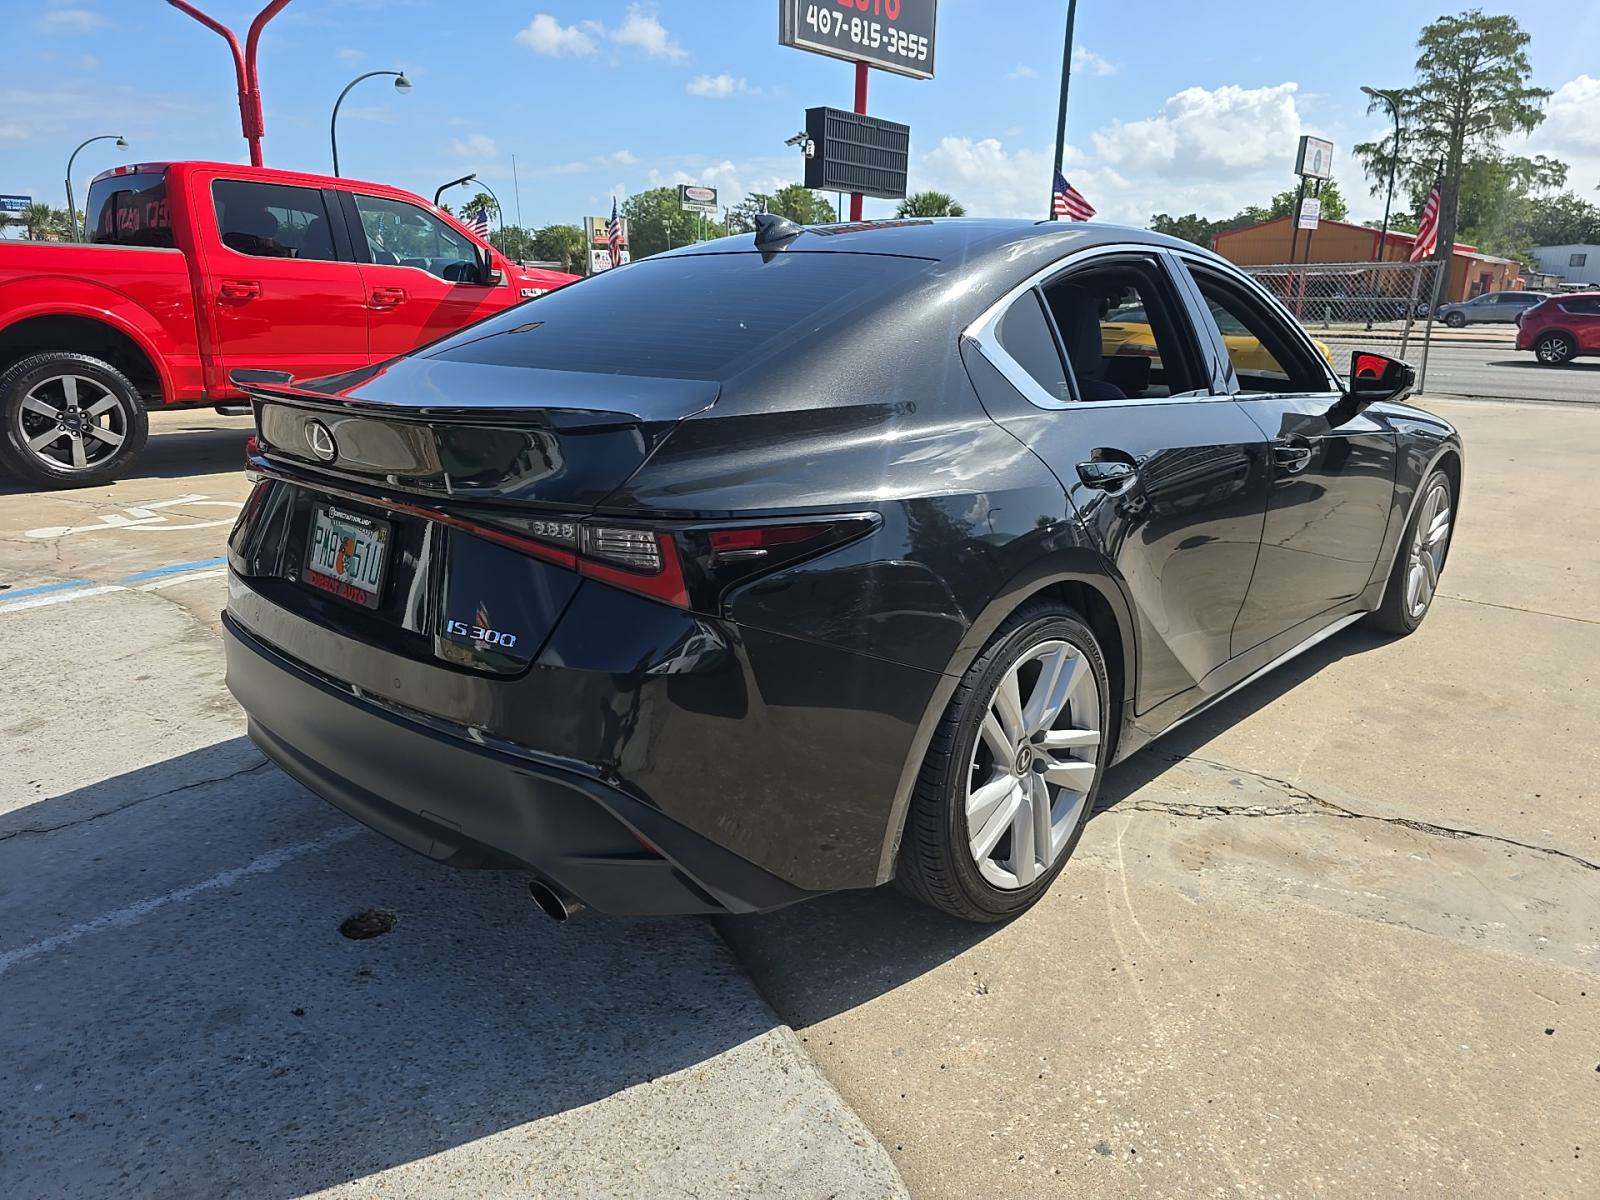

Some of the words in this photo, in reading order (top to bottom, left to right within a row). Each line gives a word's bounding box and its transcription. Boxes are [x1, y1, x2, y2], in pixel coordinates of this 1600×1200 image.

[806, 4, 928, 61] 407-815-3255
[447, 620, 468, 636] IS
[470, 625, 516, 648] 300
